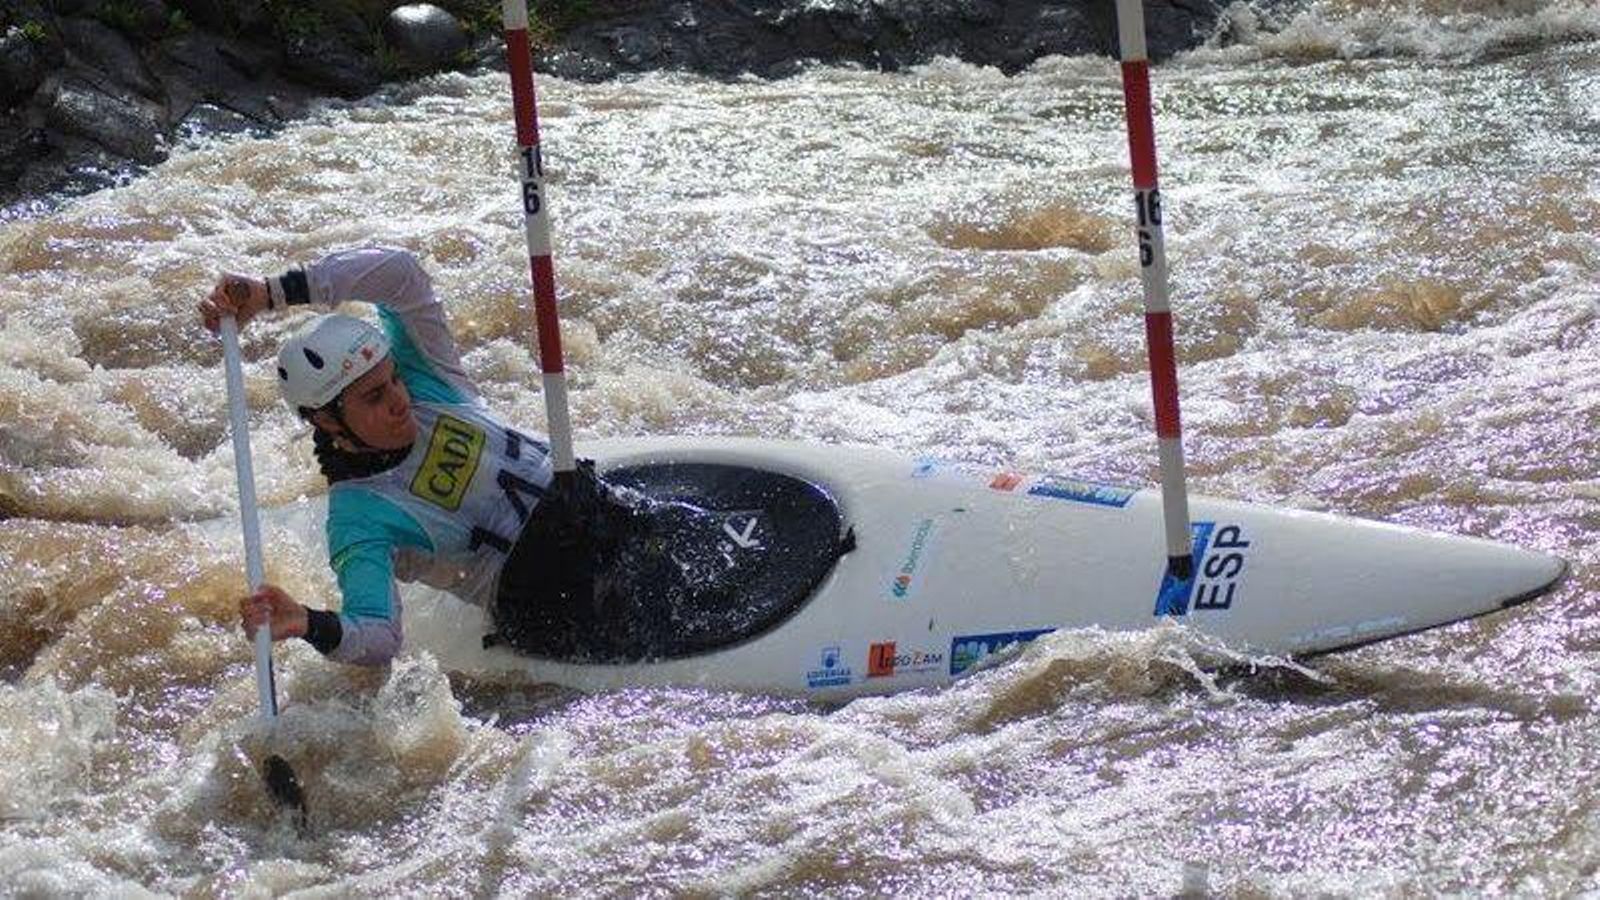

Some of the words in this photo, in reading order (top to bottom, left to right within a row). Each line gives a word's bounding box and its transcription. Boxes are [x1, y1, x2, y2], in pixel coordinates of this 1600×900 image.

[523, 181, 540, 214] 6
[1135, 189, 1161, 226] 16
[1138, 230, 1153, 267] 6
[1195, 525, 1249, 609] ESP
